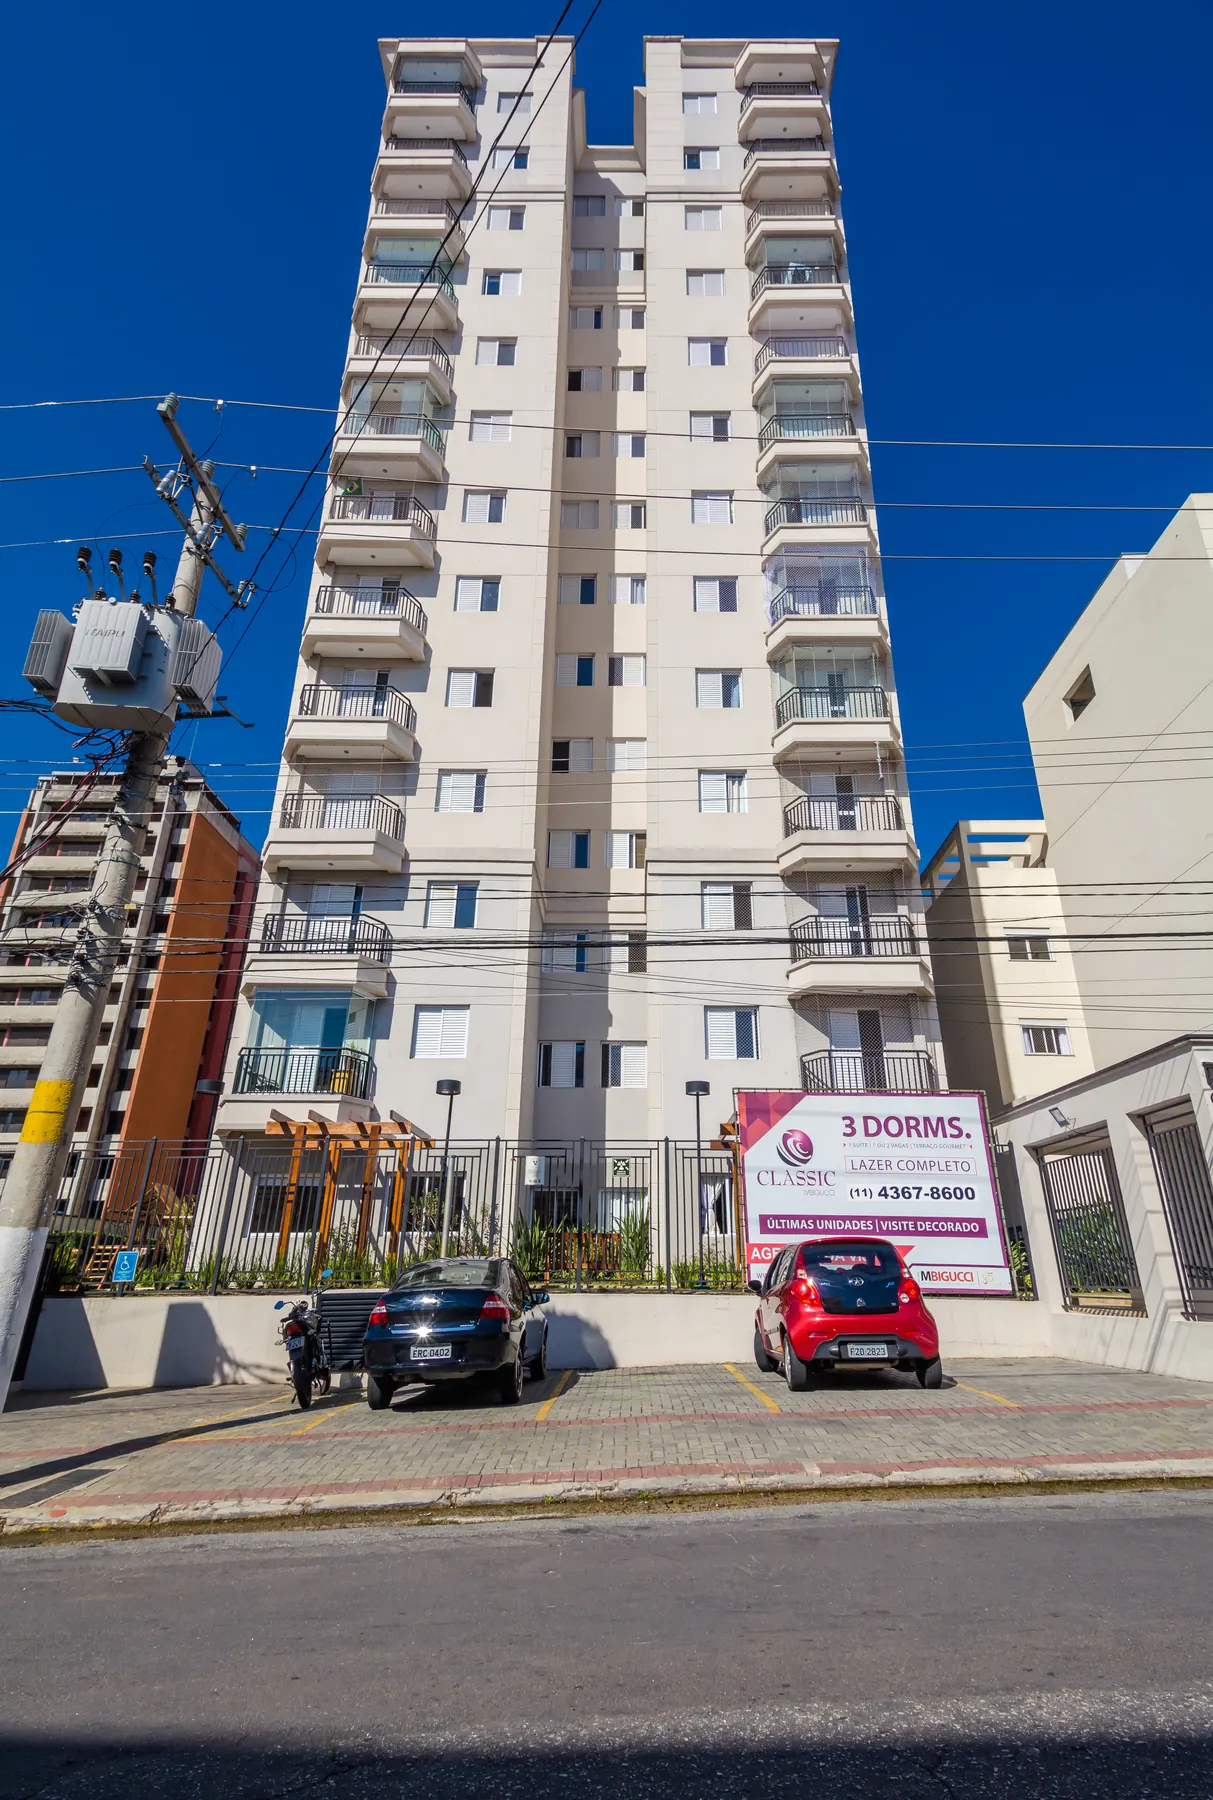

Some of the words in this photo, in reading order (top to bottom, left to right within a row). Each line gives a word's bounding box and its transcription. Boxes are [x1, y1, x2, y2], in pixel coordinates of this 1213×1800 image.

[85, 628, 126, 637] ITAIPU
[841, 1115, 857, 1138] 3
[862, 1115, 972, 1139] DORMS.
[850, 1160, 893, 1171] LAZER
[896, 1160, 971, 1172] COMPLETO
[756, 1169, 837, 1187] CLASSIC
[849, 1187, 873, 1200] (11)
[877, 1186, 976, 1200] 4367-8600
[767, 1217, 815, 1230] ÚLTIMAS
[817, 1219, 874, 1231] UNIDADES
[880, 1220, 915, 1232] VISITE
[917, 1221, 980, 1233] DECORADO
[920, 1270, 974, 1282] MBIGUCCI
